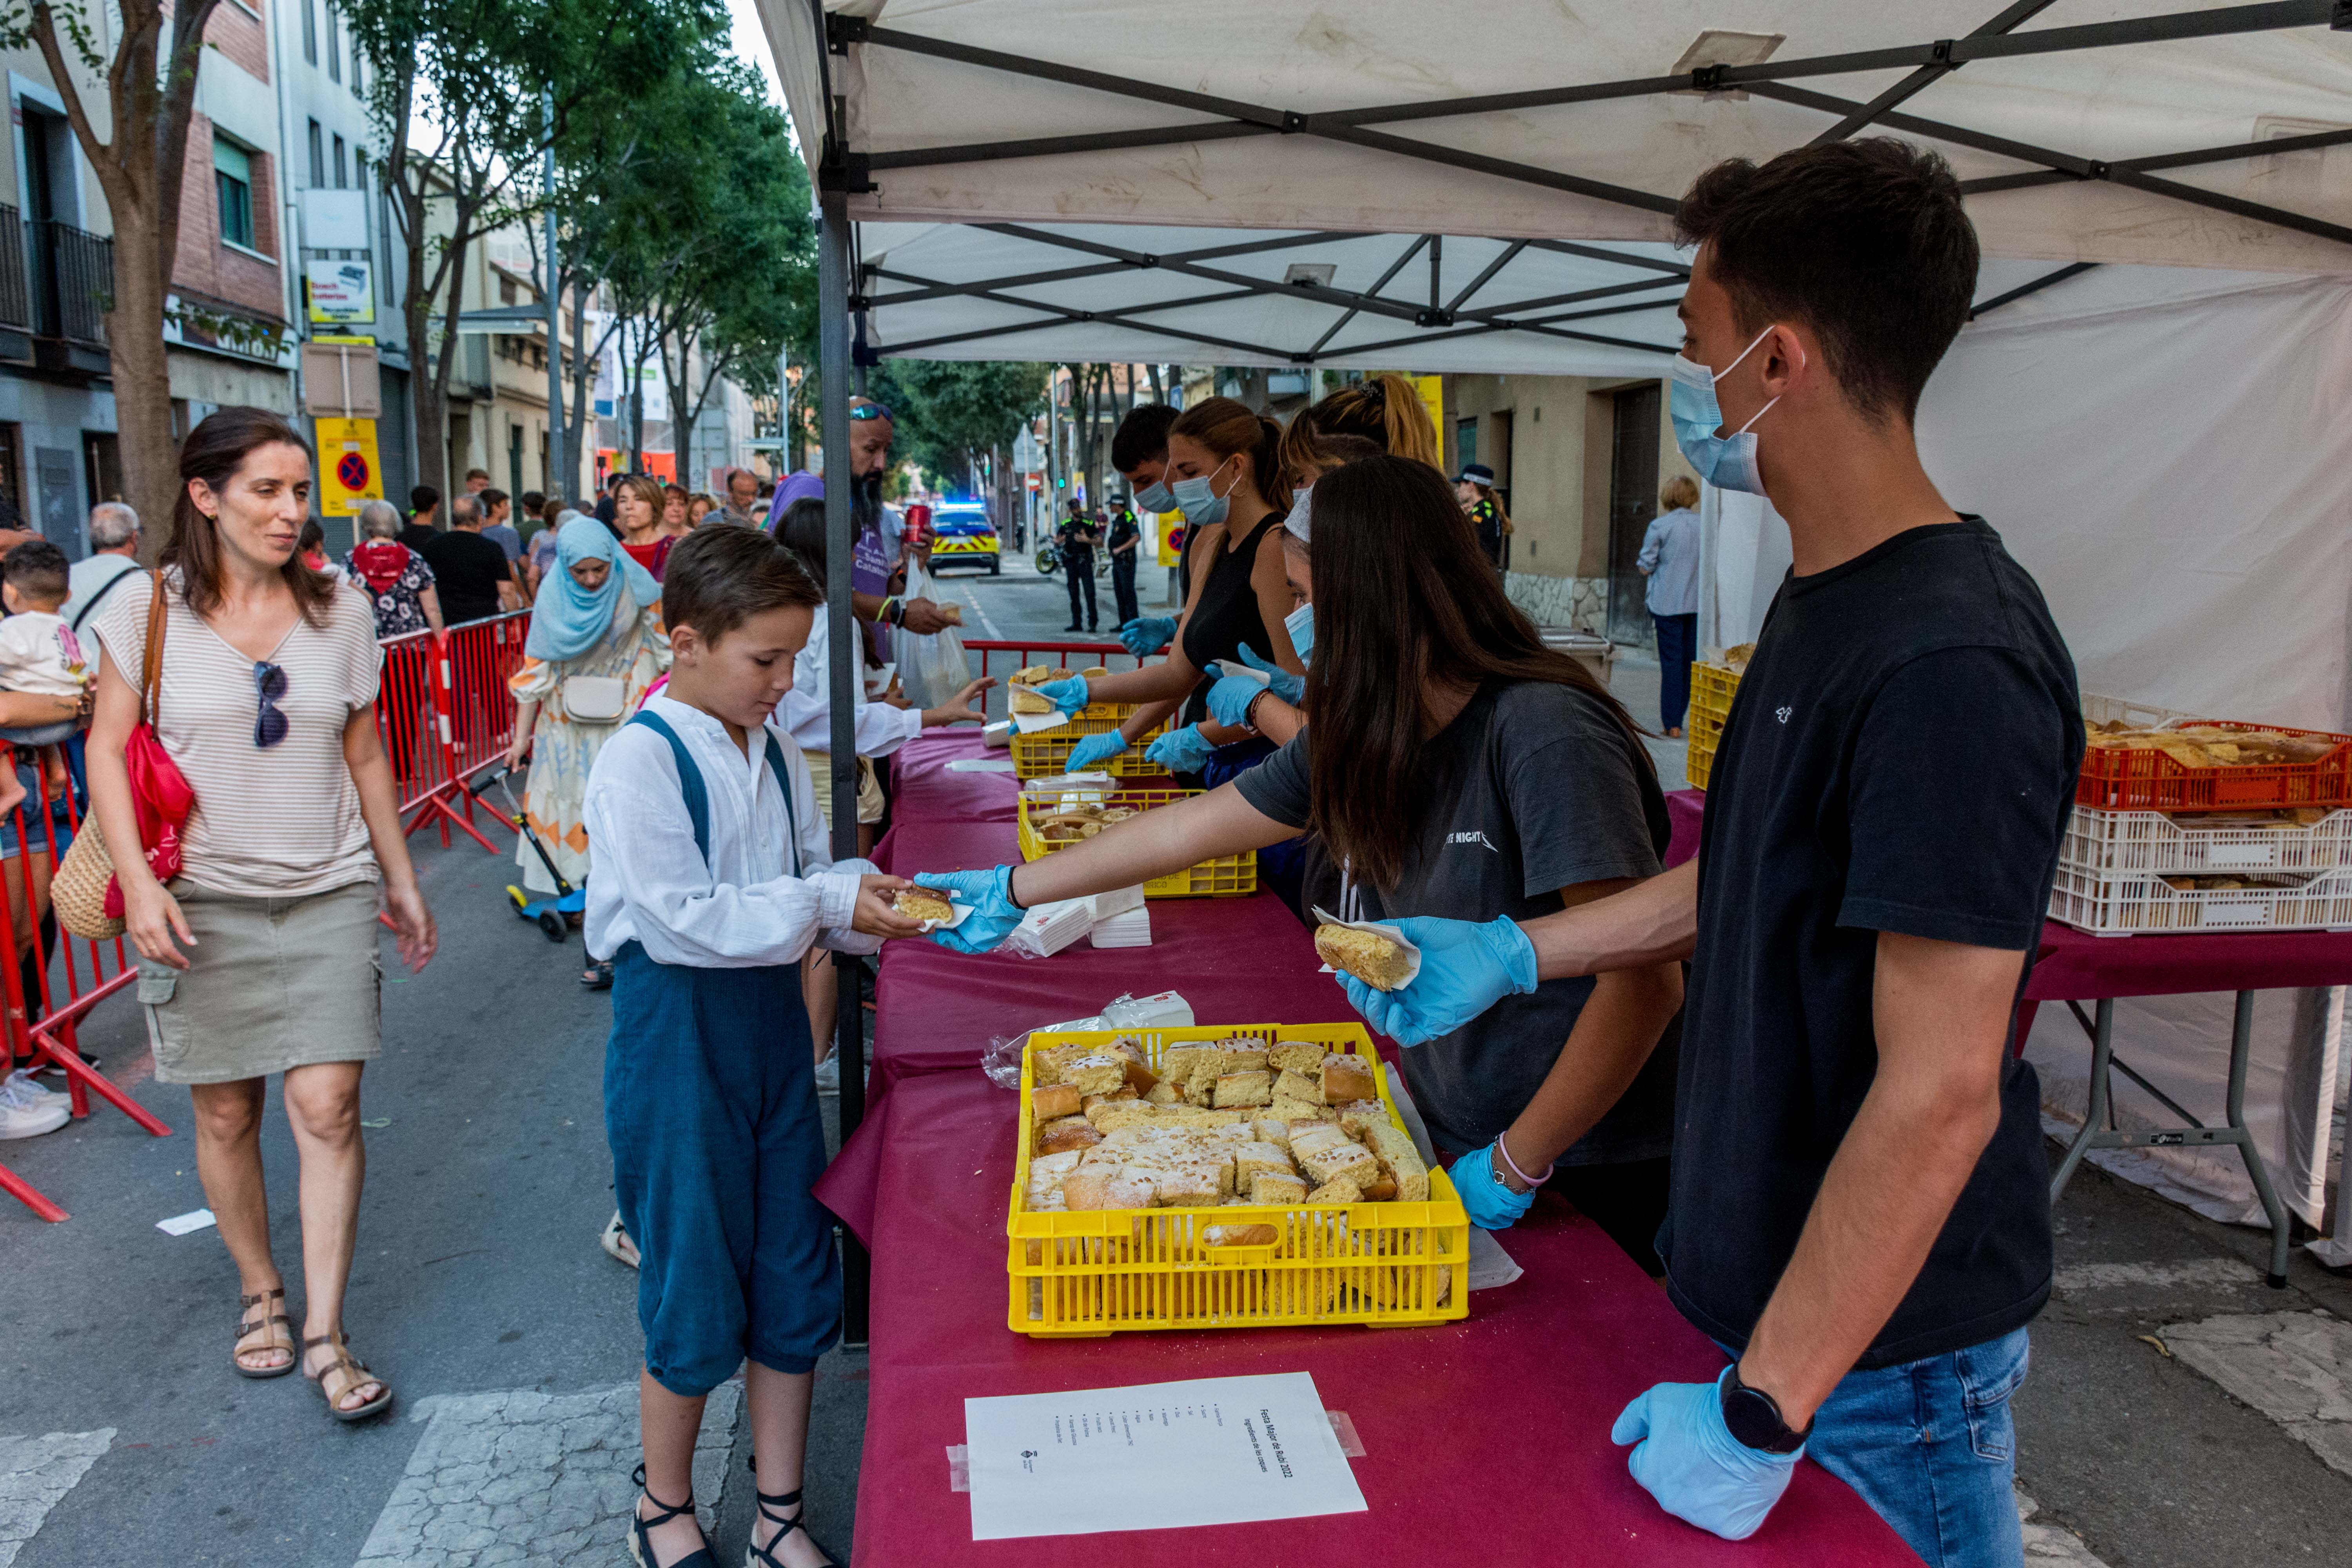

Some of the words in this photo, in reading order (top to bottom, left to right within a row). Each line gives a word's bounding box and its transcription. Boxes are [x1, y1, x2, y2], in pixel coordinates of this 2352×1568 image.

[1455, 831, 1481, 843] NIGHT
[1260, 1409, 1270, 1423] Festa
[1266, 1425, 1277, 1441] Major
[1244, 1418, 1258, 1442] Ingredients
[1258, 1457, 1268, 1472] coques
[1275, 1451, 1288, 1463] Rubí
[1280, 1465, 1293, 1478] 2022
